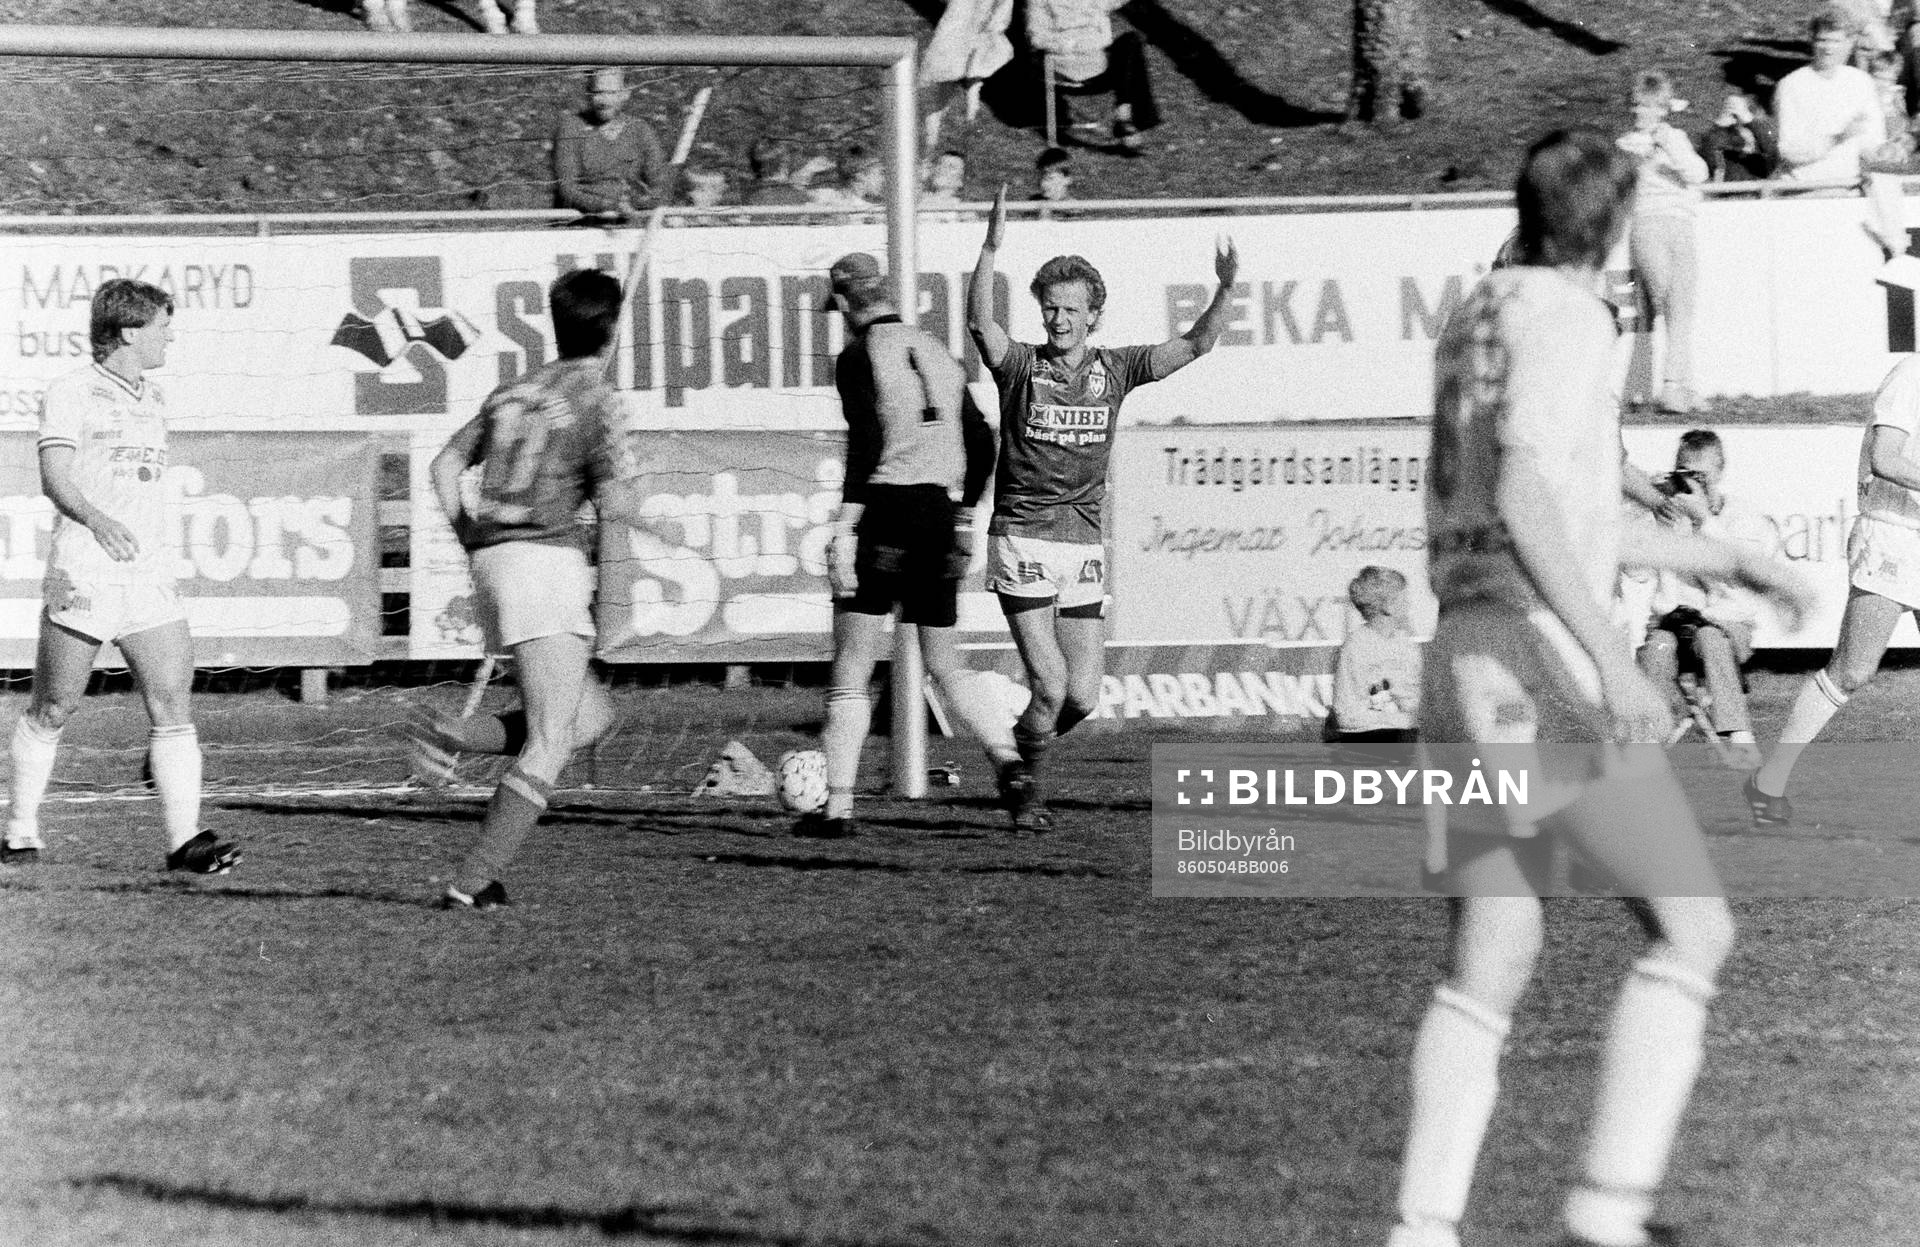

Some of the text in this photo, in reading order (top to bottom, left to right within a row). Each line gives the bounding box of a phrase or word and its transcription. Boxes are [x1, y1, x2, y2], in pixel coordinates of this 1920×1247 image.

[19, 320, 92, 357] bus
[1053, 410, 1105, 427] NIBE
[1163, 447, 1420, 492] Trädgårdsanlägg
[1308, 508, 1428, 556] Johans
[1222, 587, 1352, 641] VÄXT
[1087, 671, 1334, 720] PARBANK
